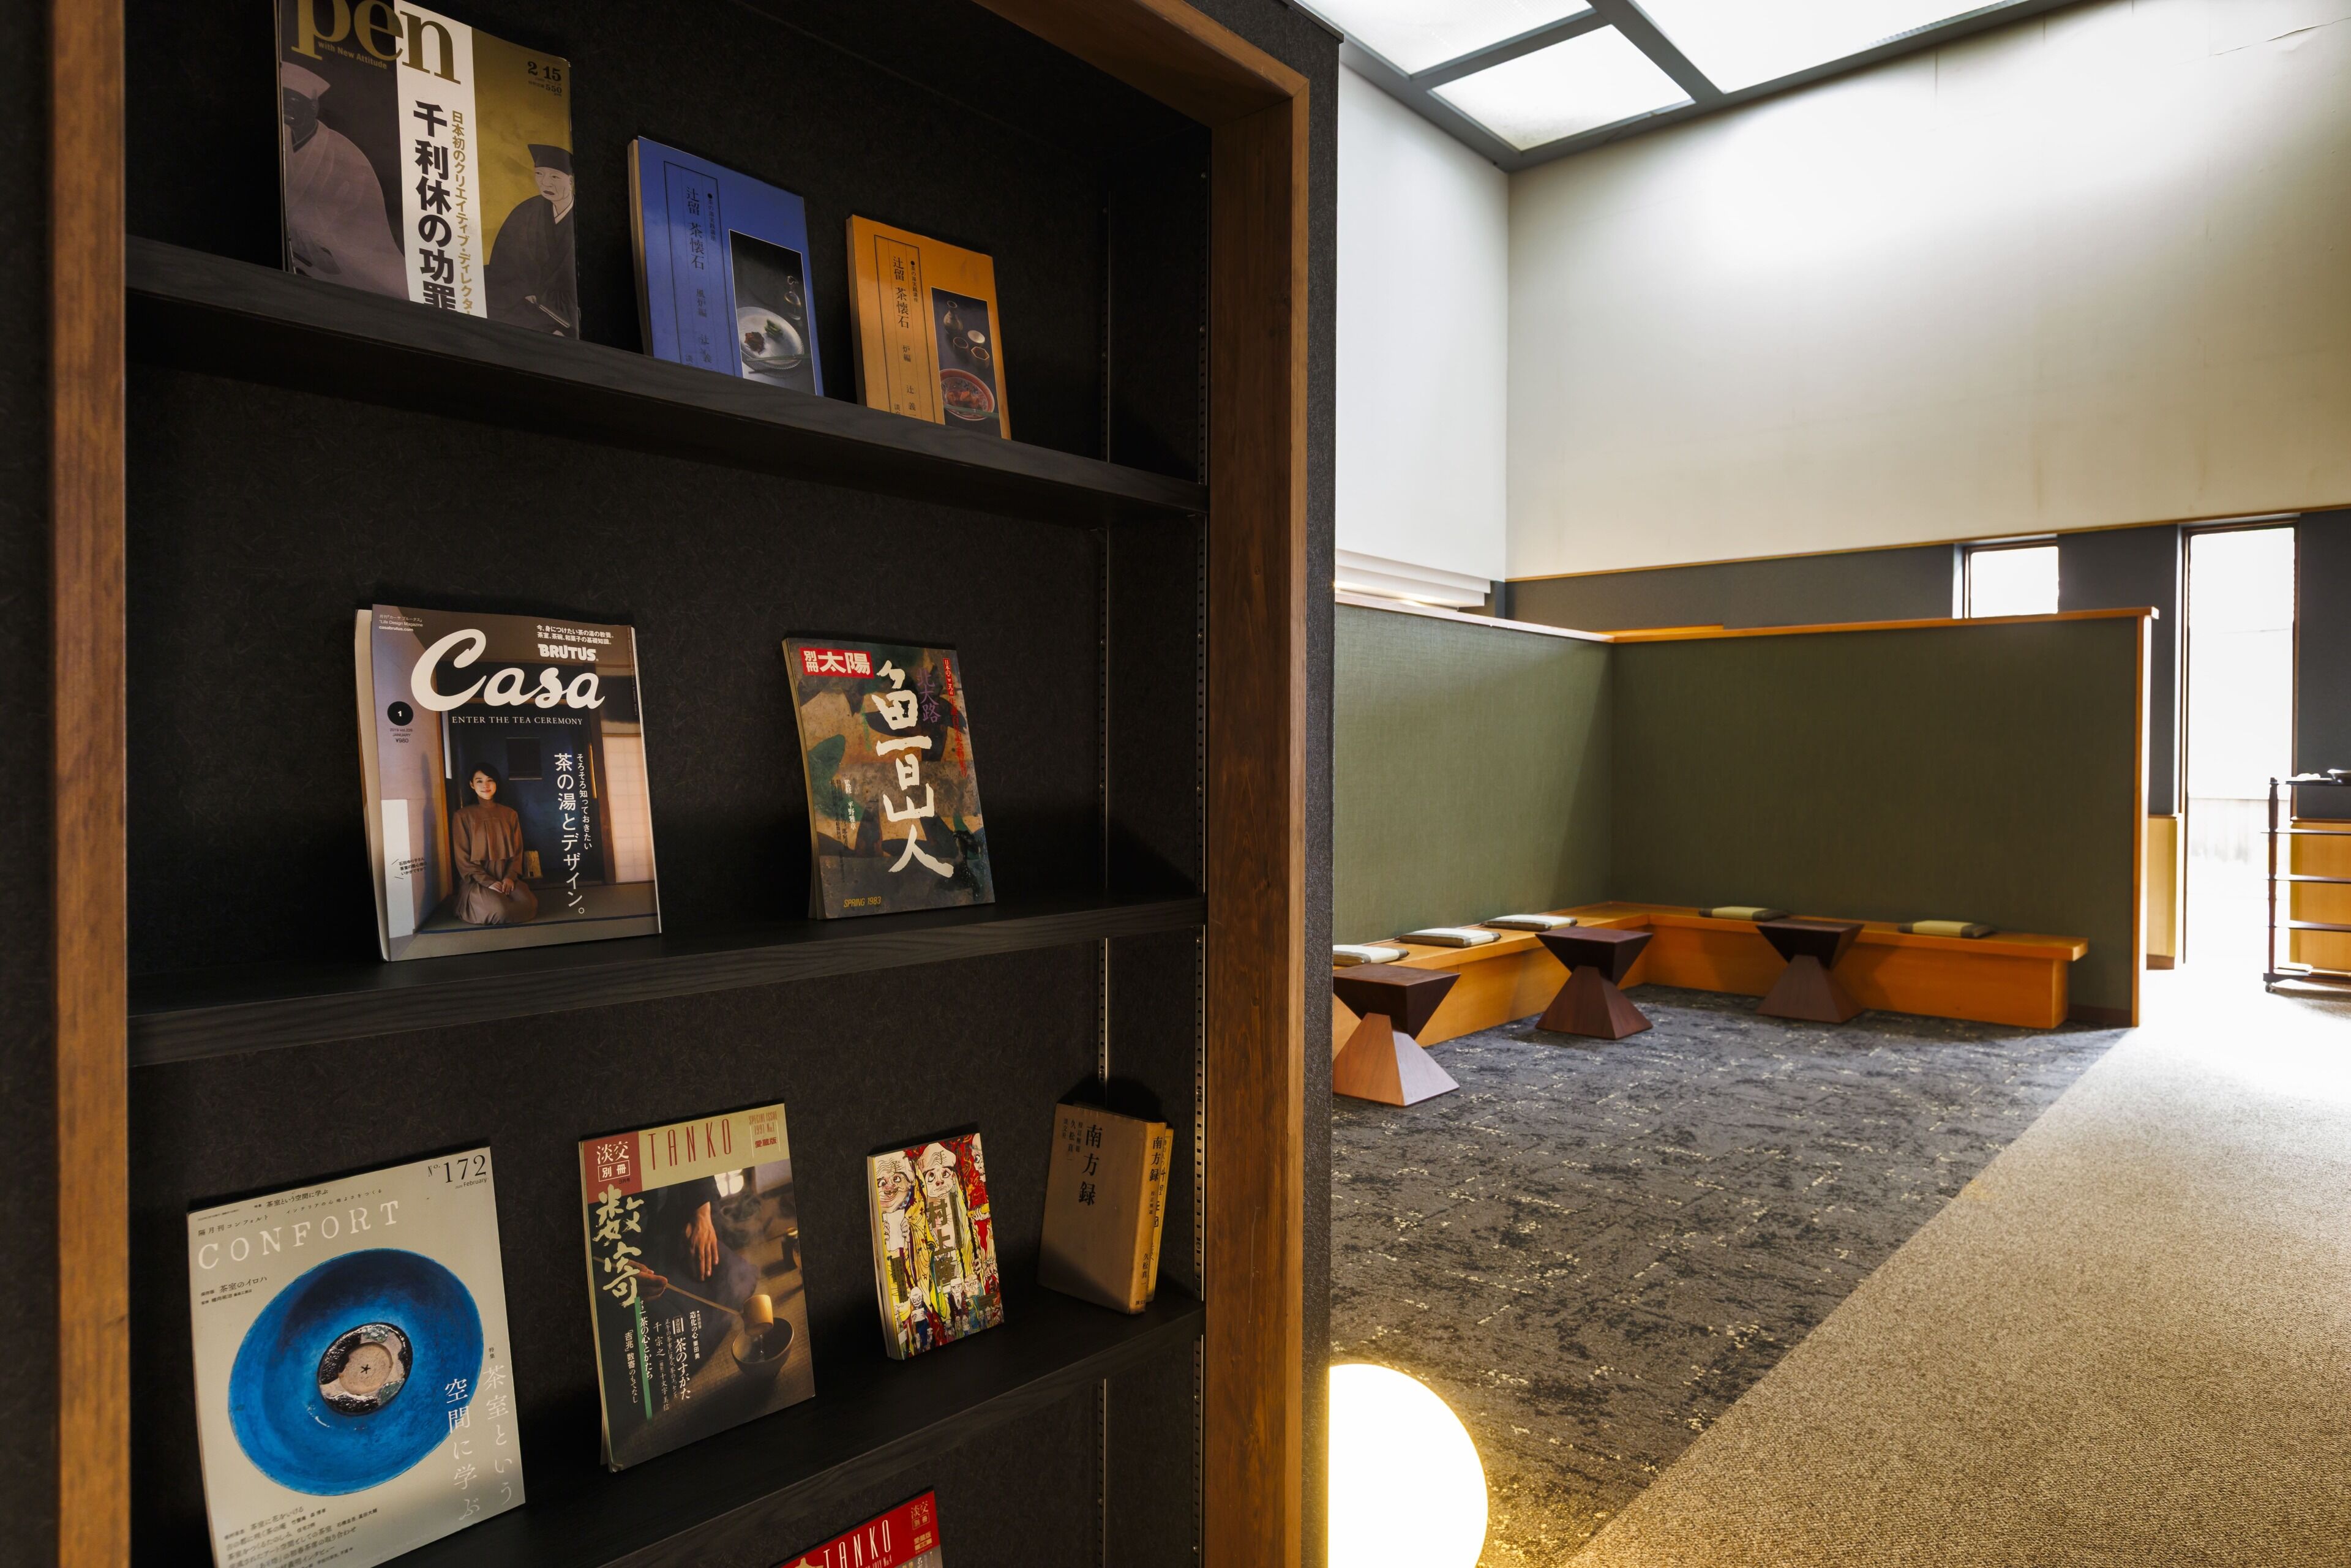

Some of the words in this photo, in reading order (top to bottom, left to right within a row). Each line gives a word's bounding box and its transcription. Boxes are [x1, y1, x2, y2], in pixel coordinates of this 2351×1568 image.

[291, 0, 461, 84] pen
[318, 41, 336, 53] with
[337, 47, 354, 59] New
[356, 53, 388, 69] Attitude
[527, 61, 538, 76] 2
[542, 66, 561, 81] 15
[413, 99, 456, 311] 千利休の功罪
[688, 222, 705, 271] 茶懐石
[893, 256, 905, 282] 辻留
[895, 287, 909, 329] 茶懐石
[536, 625, 614, 639] 今、身につけたい茶の湯の教養。
[536, 631, 612, 645] 茶室、茶碗、和菓子の基礎知識。
[537, 643, 597, 661] BRUTUS
[818, 651, 871, 675] 太陽
[411, 628, 605, 711] Casa
[917, 667, 941, 724] 北大路
[452, 716, 486, 724] ENTER
[489, 716, 509, 724] THE
[512, 716, 531, 724] TEA
[534, 716, 583, 725] CEREMONY
[576, 753, 593, 851] そろそろ知っておきたい
[553, 752, 585, 915] 茶の湯とデザイン。
[843, 898, 865, 907] SPRING
[867, 896, 882, 906] 1983
[596, 1141, 629, 1165] 淡交
[648, 1118, 732, 1171] TANKO
[1149, 1136, 1163, 1182] 南方録
[443, 1155, 487, 1184] 172
[602, 1163, 626, 1178] 別冊
[1078, 1124, 1103, 1206] 南方録
[463, 1177, 487, 1187] February
[266, 1189, 329, 1208] 茶室という空間に学ぶ
[198, 1200, 399, 1269] CONFORT
[220, 1276, 268, 1293] 茶室のイロハ
[489, 1346, 495, 1359] 特集
[675, 1337, 692, 1401] 茶のすがた
[444, 1378, 481, 1521] 空間に学ぶ
[482, 1365, 512, 1506] 茶室という
[911, 1501, 929, 1520] 淡交
[823, 1520, 891, 1568] TANKO
